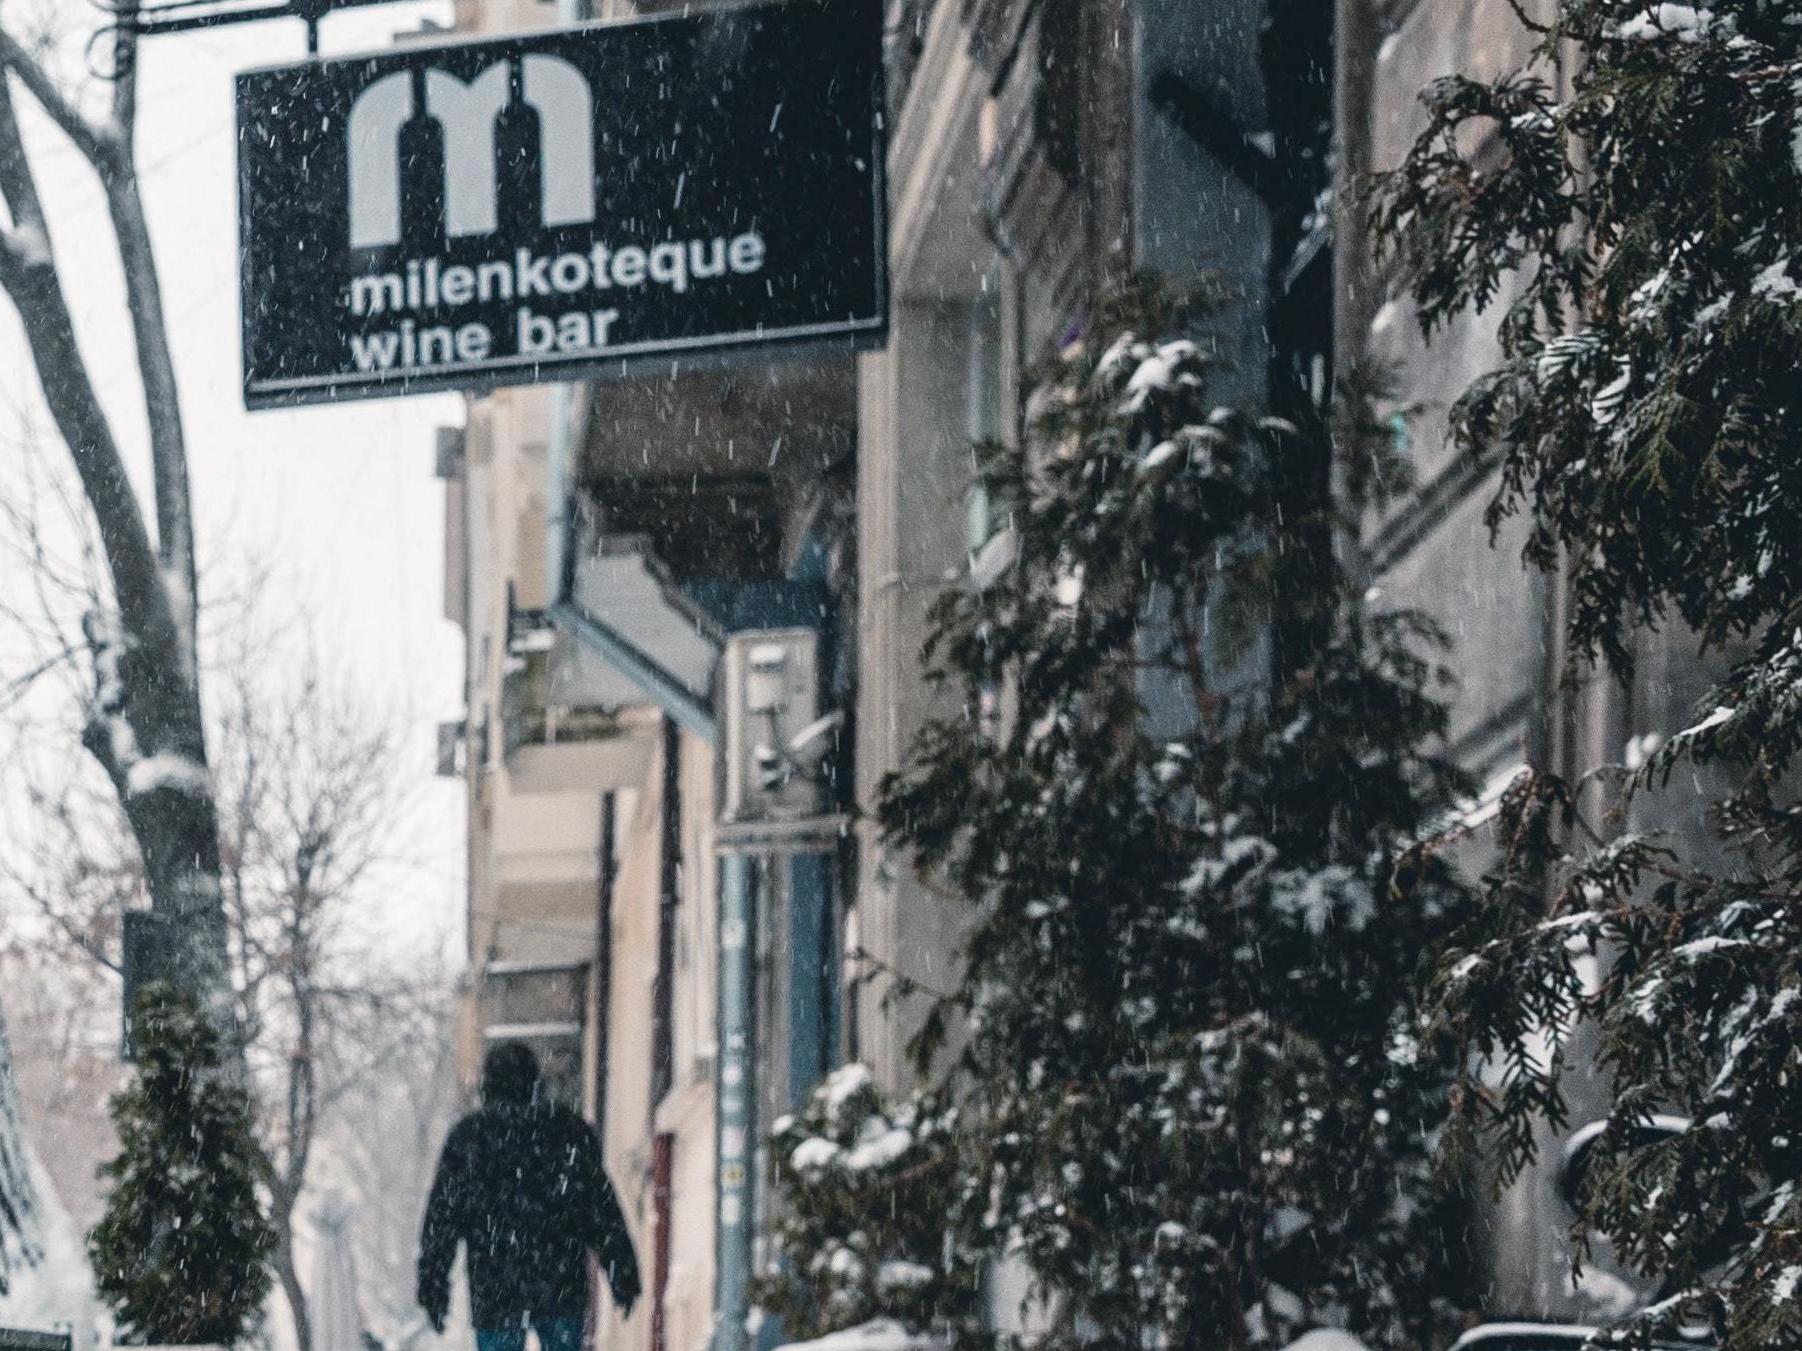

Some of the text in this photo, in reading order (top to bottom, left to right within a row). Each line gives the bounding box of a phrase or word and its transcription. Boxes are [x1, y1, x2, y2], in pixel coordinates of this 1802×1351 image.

[349, 231, 768, 316] milenkoteque
[349, 307, 620, 371] wine bar
